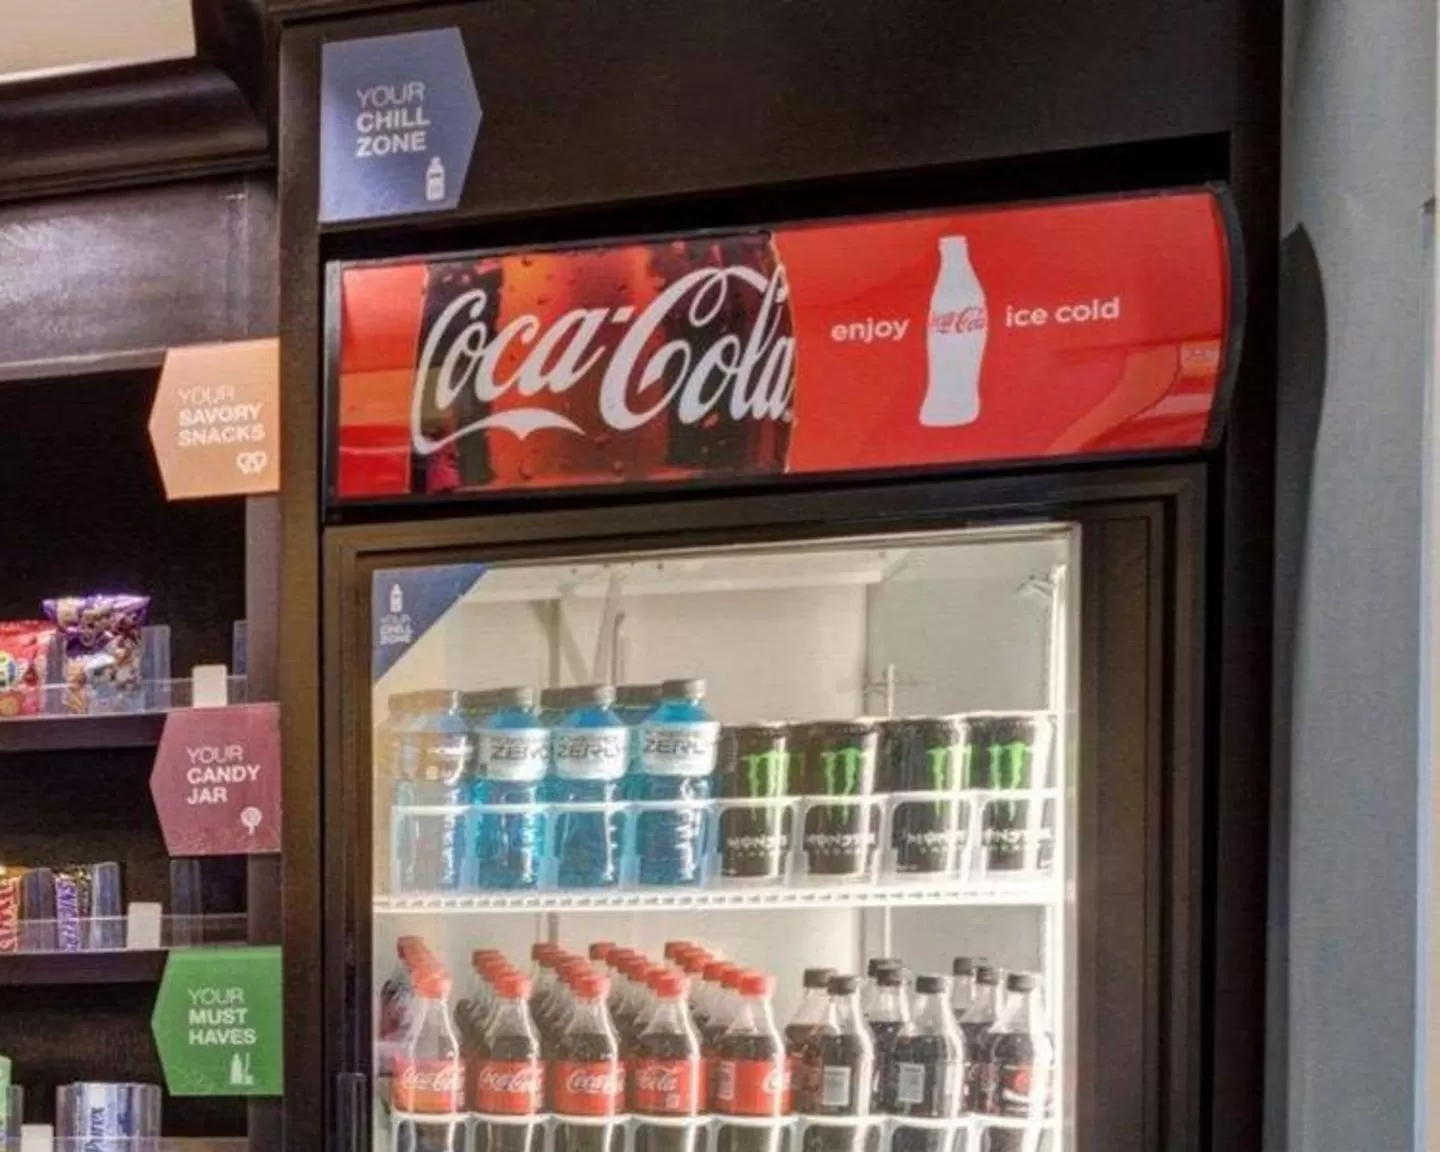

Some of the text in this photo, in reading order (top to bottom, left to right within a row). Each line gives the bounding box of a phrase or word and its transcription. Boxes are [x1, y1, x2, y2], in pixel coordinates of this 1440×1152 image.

[357, 82, 425, 109] YOUR
[356, 106, 430, 133] CHILL
[356, 130, 426, 157] ZONE
[1005, 297, 1121, 328] ice cold
[831, 317, 910, 343] enjoy
[410, 264, 797, 456] Coca-Cola
[176, 383, 236, 405] YOUR
[179, 402, 264, 427] SAVORY
[178, 423, 266, 448] SNACKS
[187, 744, 244, 764] YOUR
[187, 764, 261, 785] CANDY
[187, 786, 229, 805] JAR
[188, 986, 245, 1005] YOUR
[188, 1007, 248, 1026] MUST
[188, 1028, 258, 1046] HAVES
